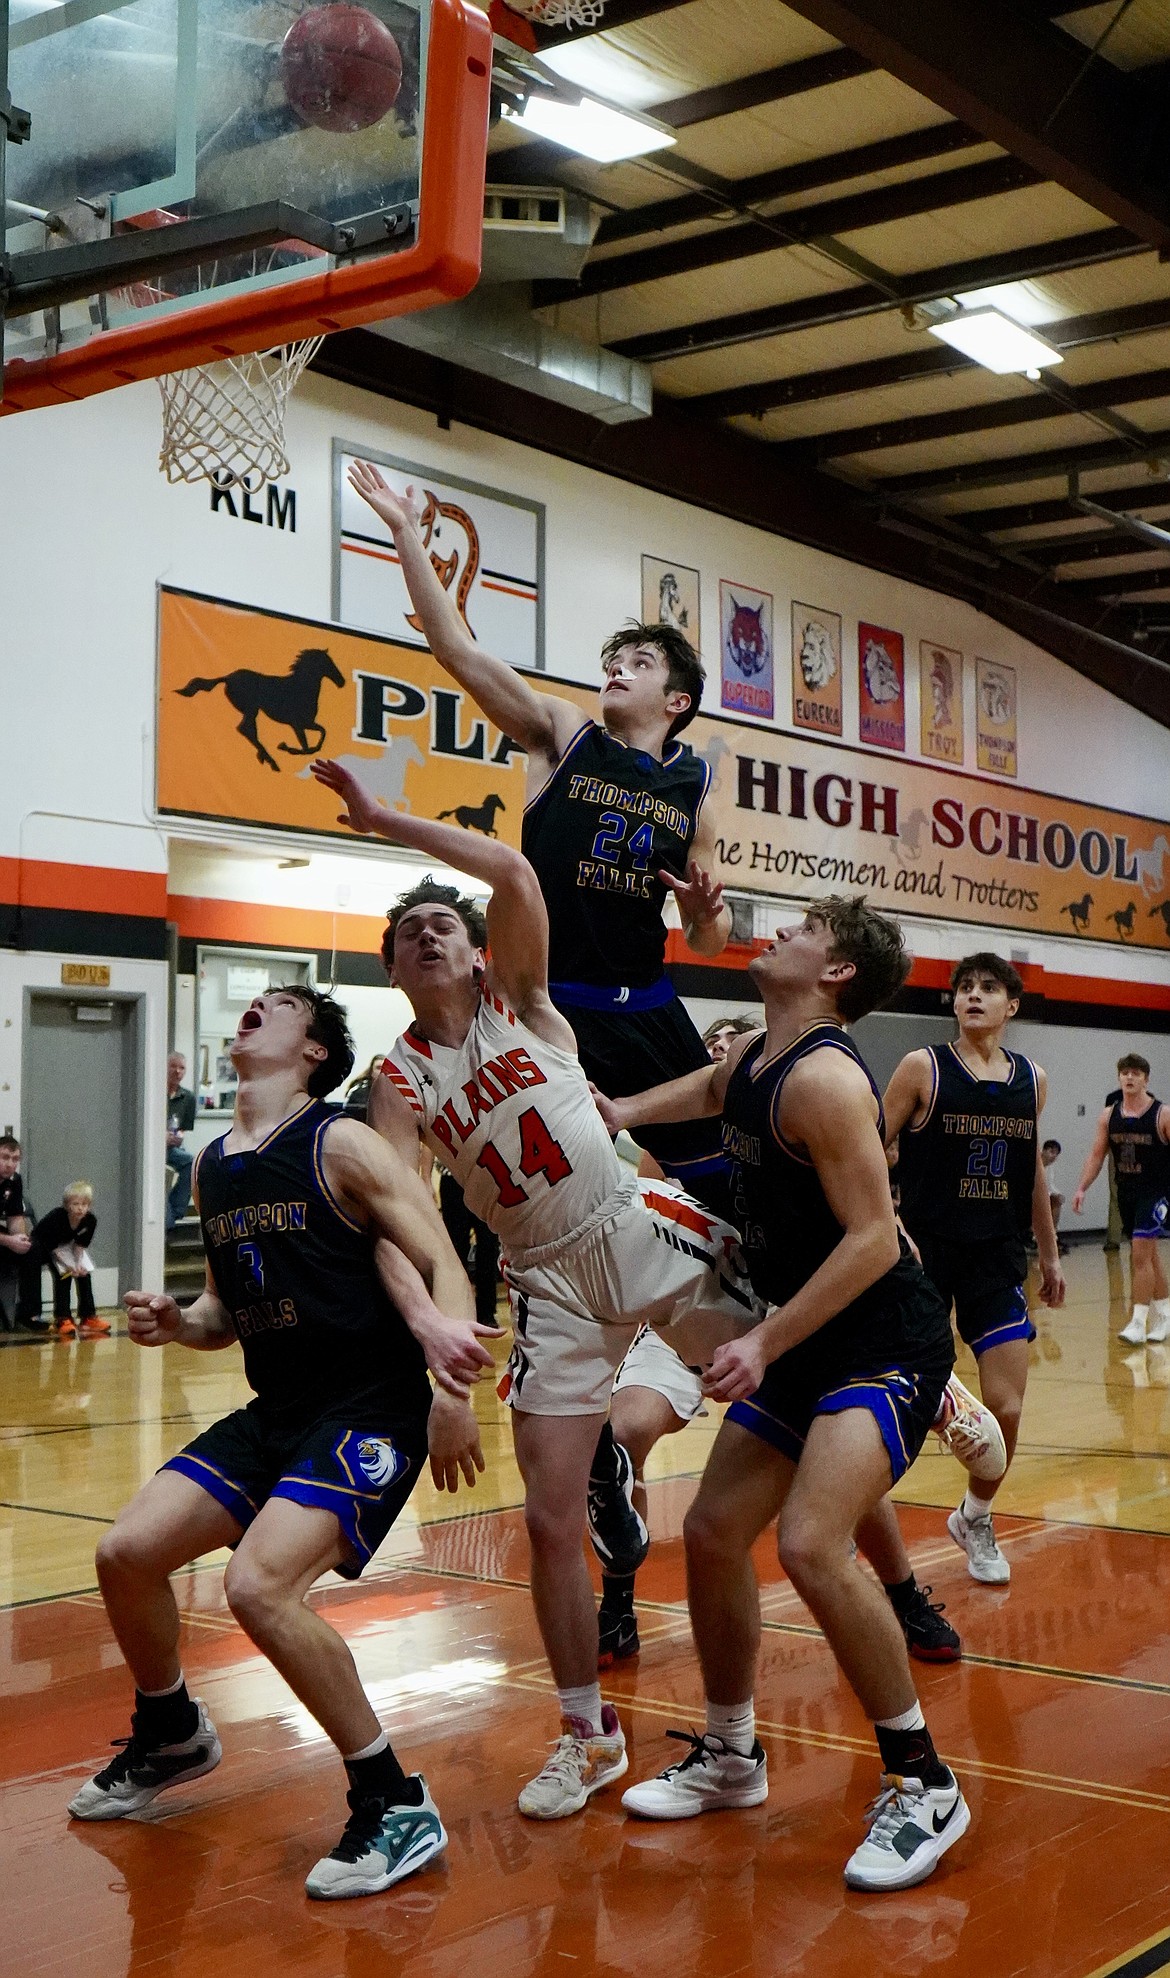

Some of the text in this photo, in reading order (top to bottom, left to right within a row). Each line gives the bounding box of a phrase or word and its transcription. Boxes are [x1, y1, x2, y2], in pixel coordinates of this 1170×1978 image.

[209, 470, 296, 533] KLM
[723, 680, 771, 710] SUPERIOR
[795, 699, 840, 728] EUREKA
[927, 731, 958, 758] TROY
[568, 774, 690, 840] THOMPSON
[735, 755, 1140, 883] HIGH SCHOOL
[591, 811, 655, 871] 24
[576, 861, 654, 898] FALLS
[749, 841, 889, 889] Horsemen
[895, 861, 946, 898] and
[951, 874, 1040, 912] Trotters
[430, 1047, 548, 1159] PLAINS
[943, 1113, 1034, 1139] THOMPSON
[476, 1105, 574, 1209] 14
[966, 1138, 1008, 1177] 20
[958, 1179, 1009, 1200] FALLS
[237, 1241, 265, 1296] 3
